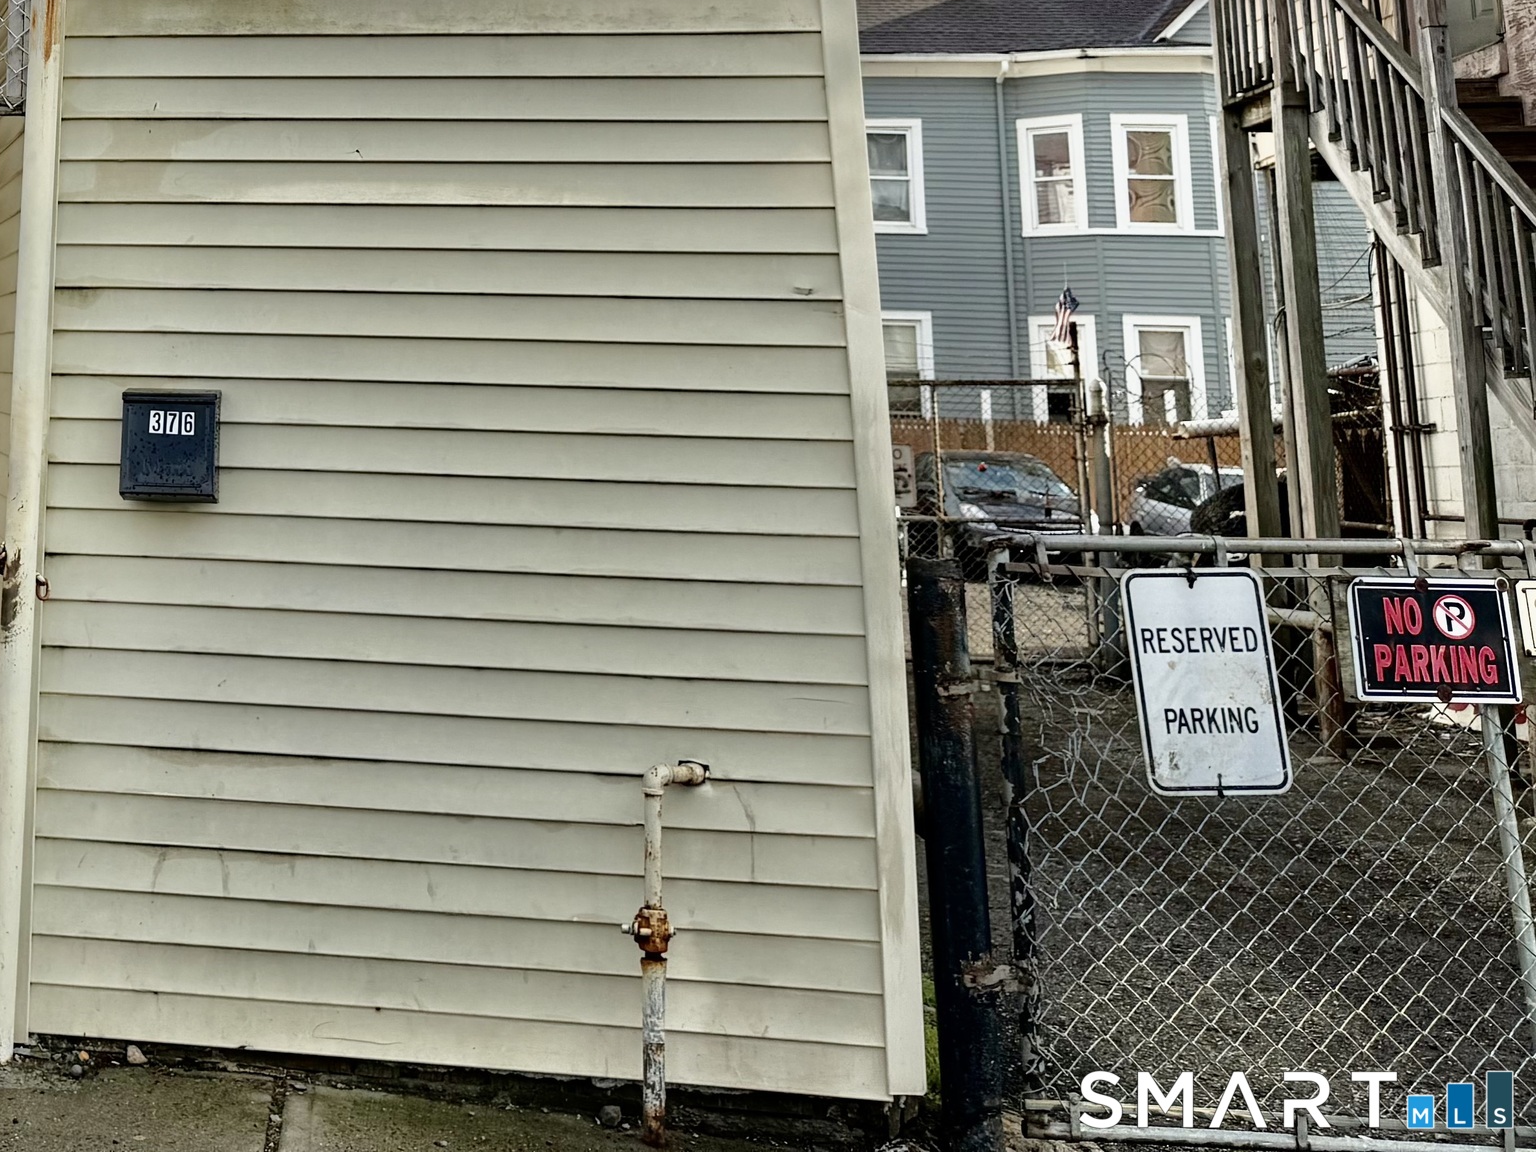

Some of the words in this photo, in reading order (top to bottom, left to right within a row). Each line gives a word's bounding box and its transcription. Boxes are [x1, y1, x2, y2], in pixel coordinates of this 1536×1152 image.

[151, 411, 194, 434] 376
[1382, 596, 1423, 636] NO
[1140, 626, 1259, 654] RESERVED
[1372, 643, 1500, 685] PARKING
[1164, 706, 1260, 735] PARKING
